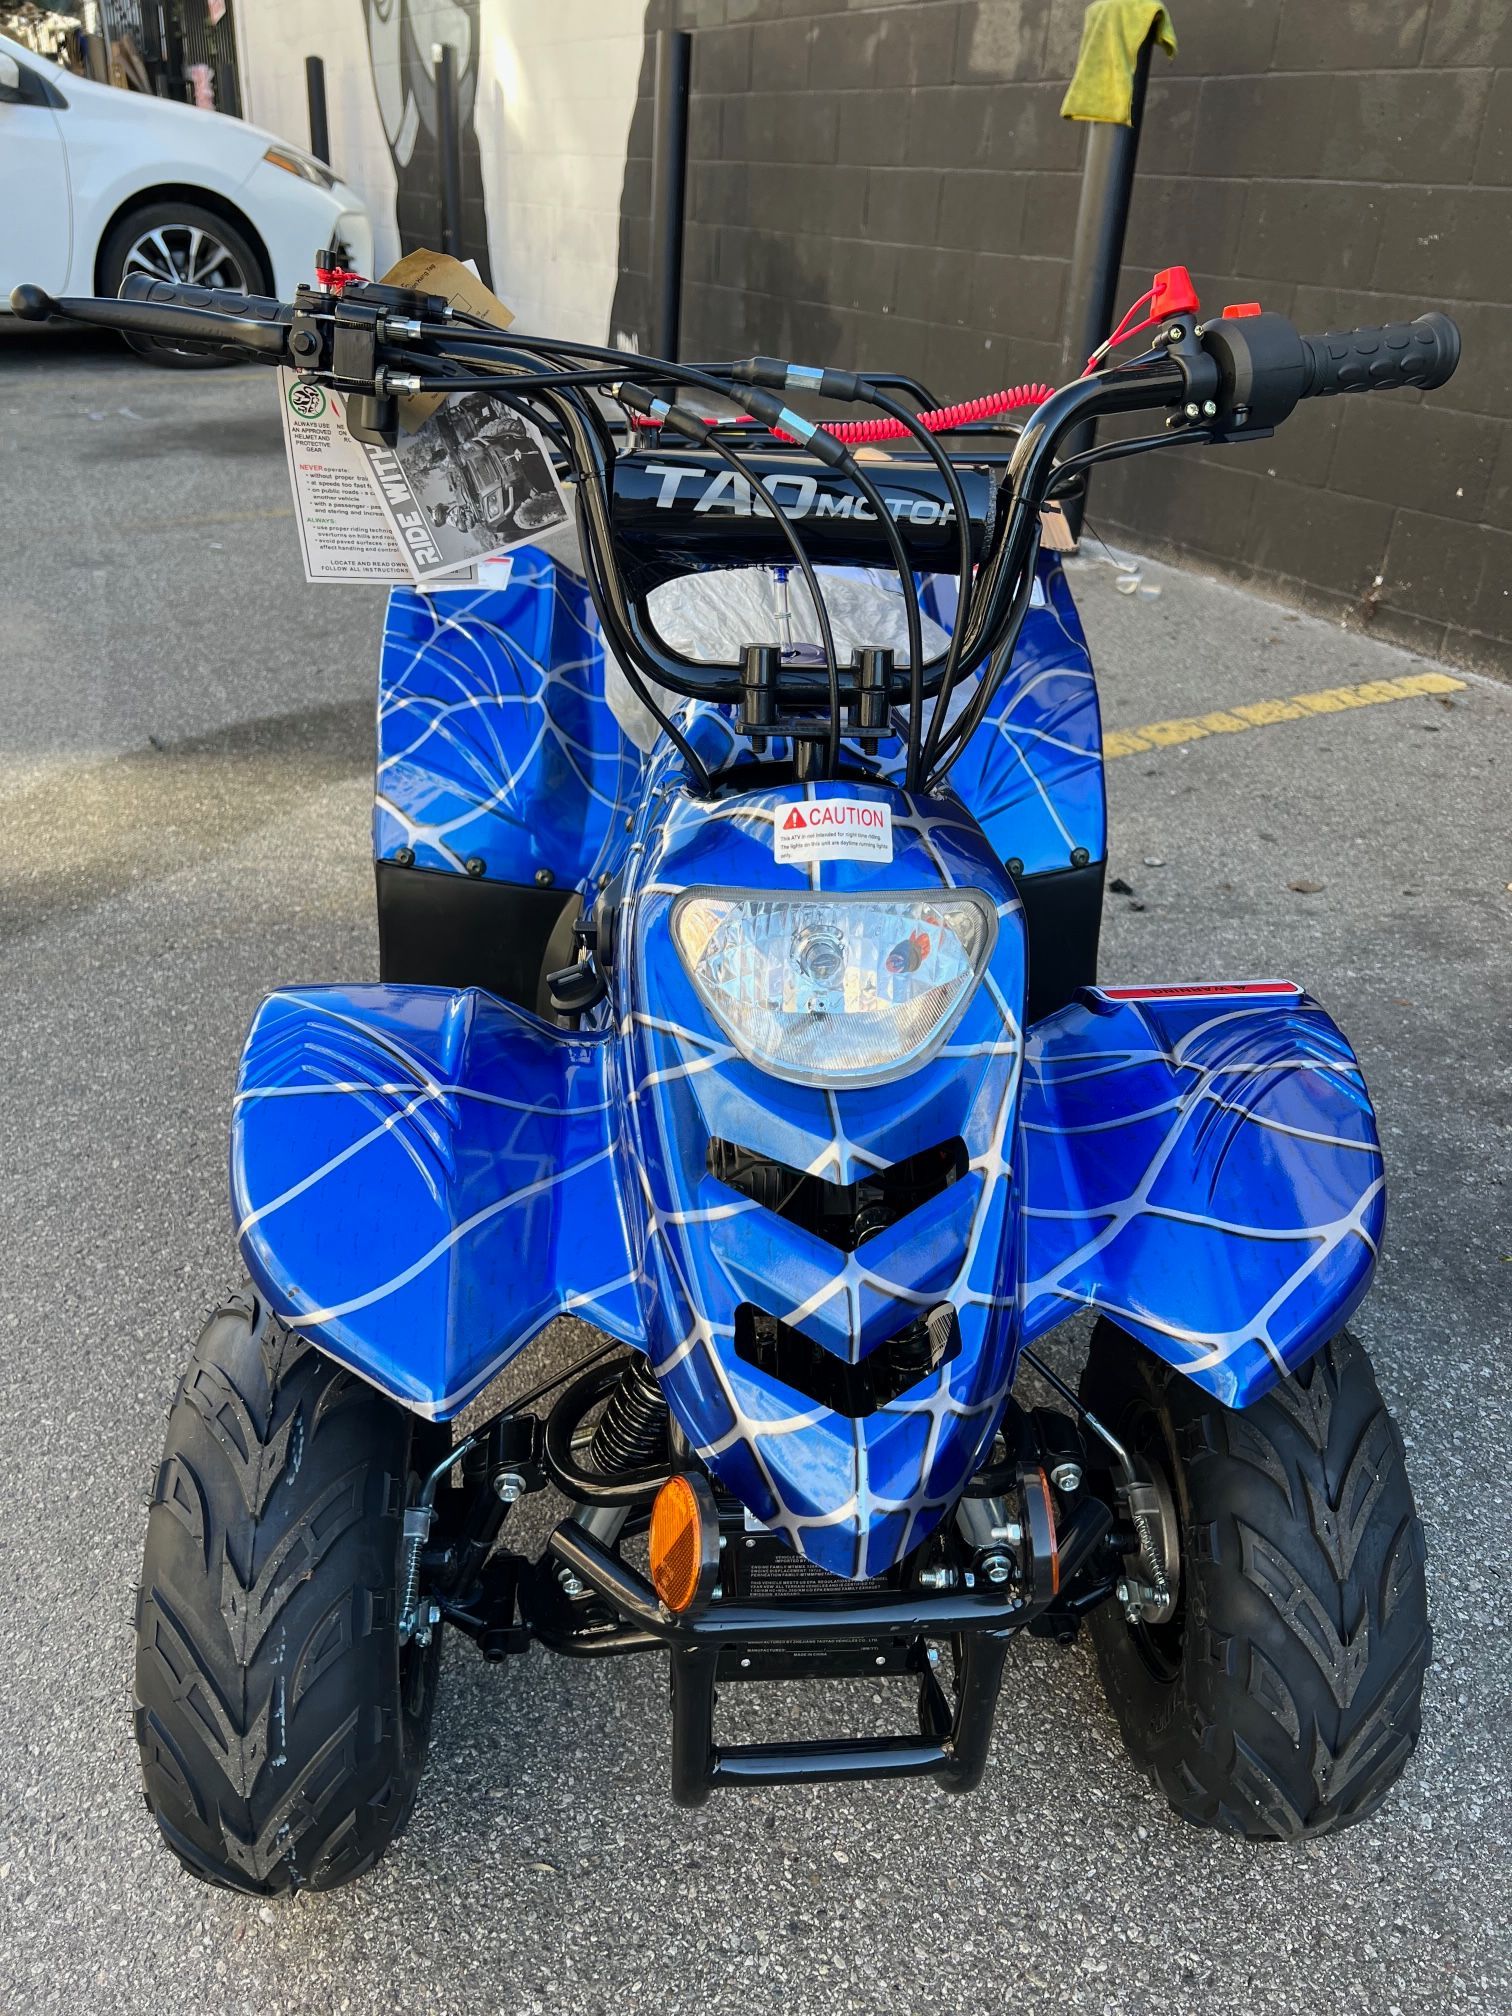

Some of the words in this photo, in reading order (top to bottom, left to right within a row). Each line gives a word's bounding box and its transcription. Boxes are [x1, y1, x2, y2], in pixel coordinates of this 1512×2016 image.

[416, 270, 429, 284] Hang
[426, 263, 436, 273] Tag
[396, 510, 440, 566] RIDE
[809, 806, 884, 828] CAUTION
